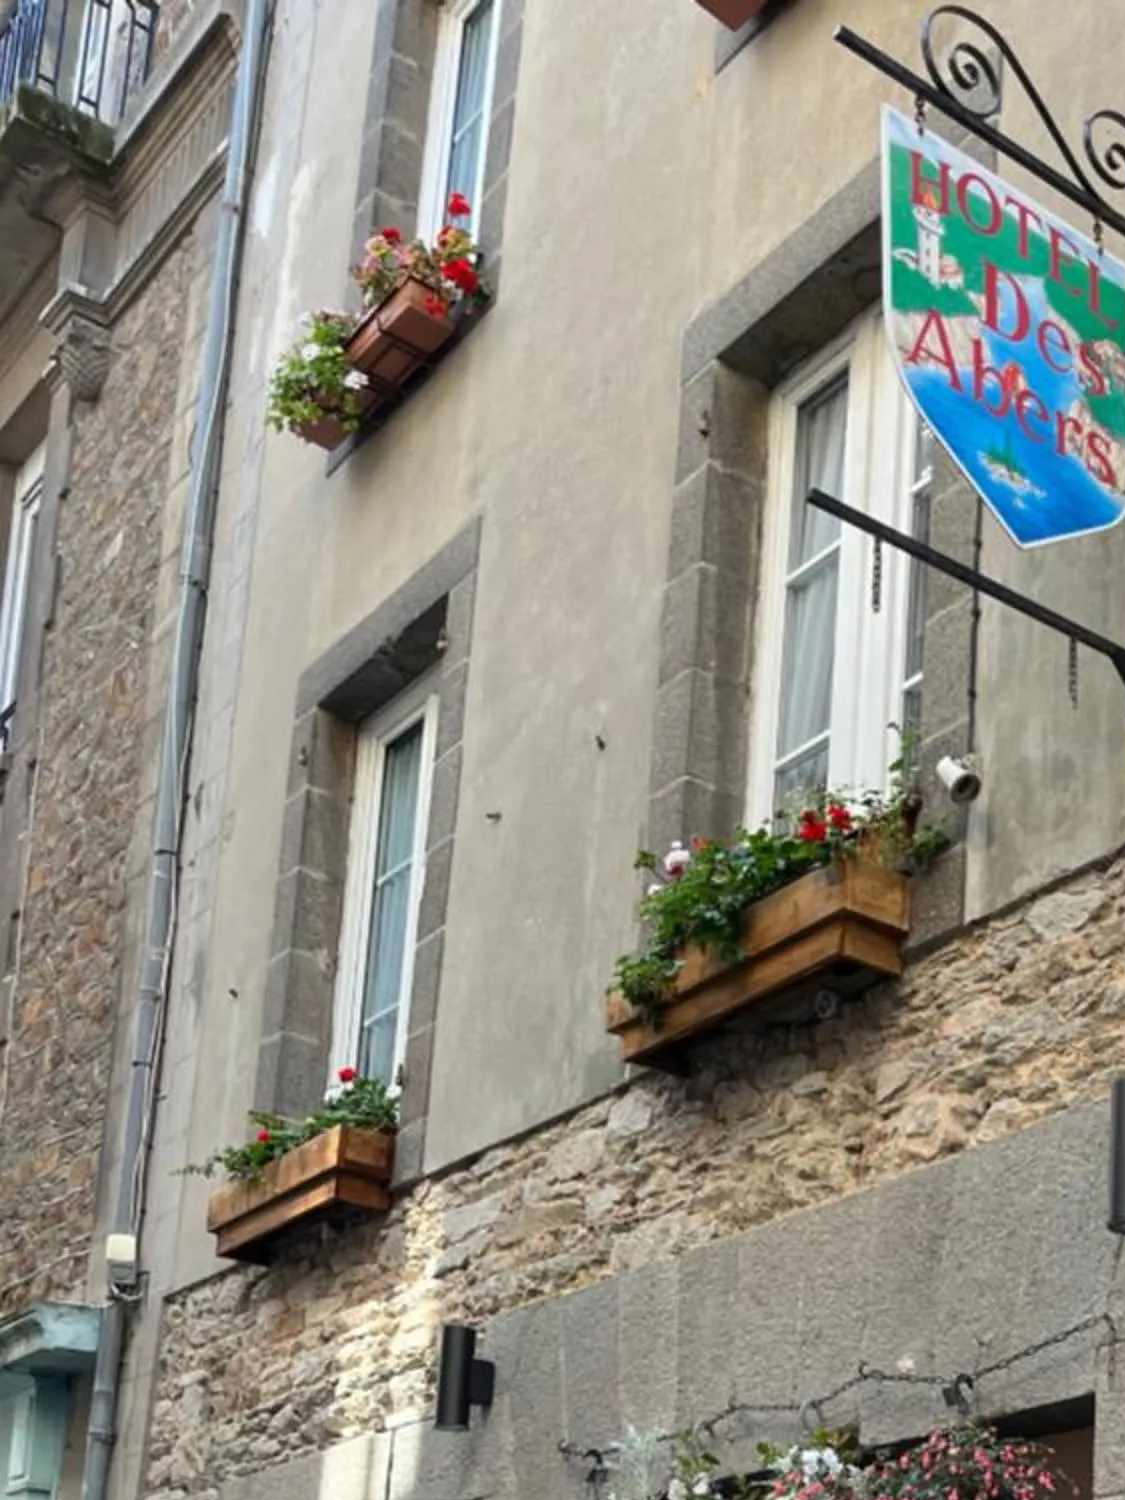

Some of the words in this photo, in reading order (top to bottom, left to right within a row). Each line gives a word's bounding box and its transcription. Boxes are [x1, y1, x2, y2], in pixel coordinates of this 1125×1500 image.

[910, 151, 1120, 330] HOTEL
[980, 258, 1107, 397] Des
[907, 309, 1117, 490] Abers
